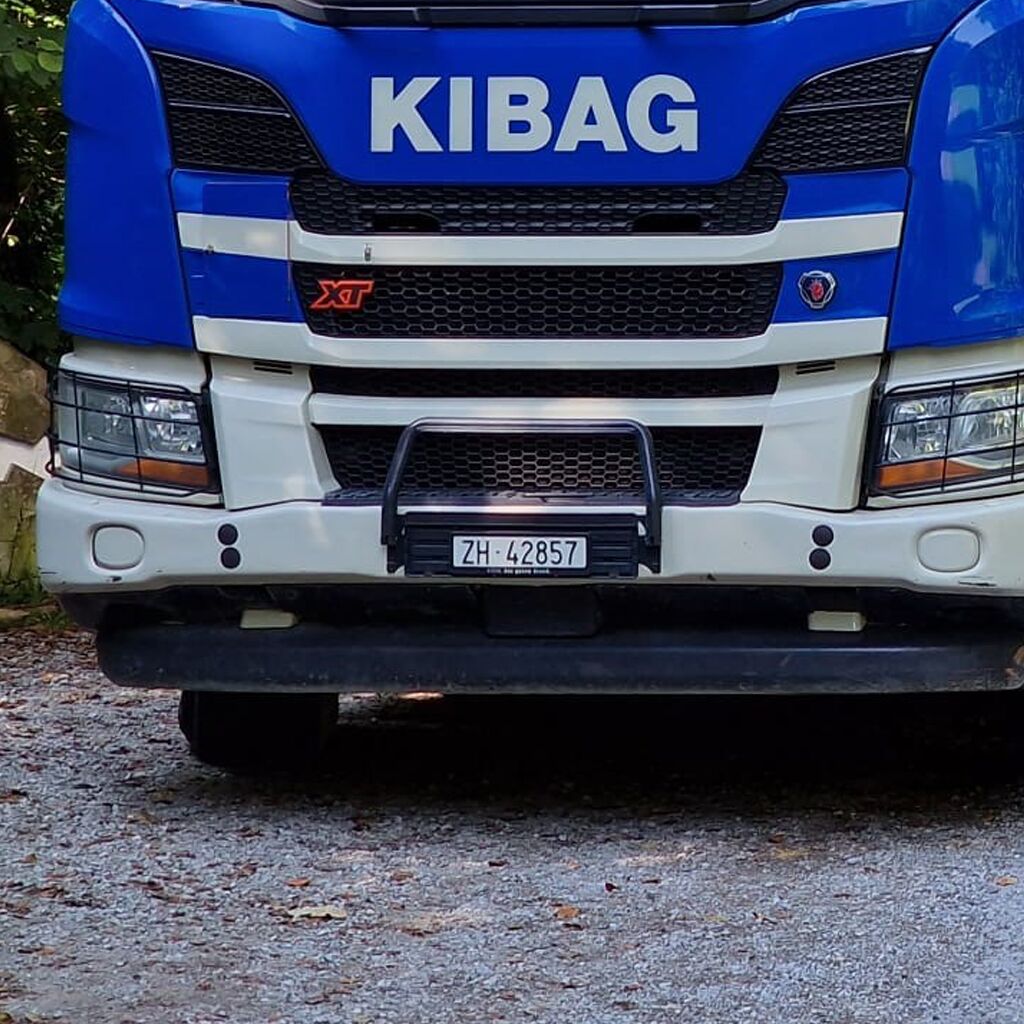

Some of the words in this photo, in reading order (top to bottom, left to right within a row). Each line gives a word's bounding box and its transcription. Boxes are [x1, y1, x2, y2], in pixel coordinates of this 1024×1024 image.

[370, 74, 698, 153] KIBAG
[311, 280, 374, 308] XT
[462, 540, 489, 565] ZH
[506, 540, 577, 566] 42857
